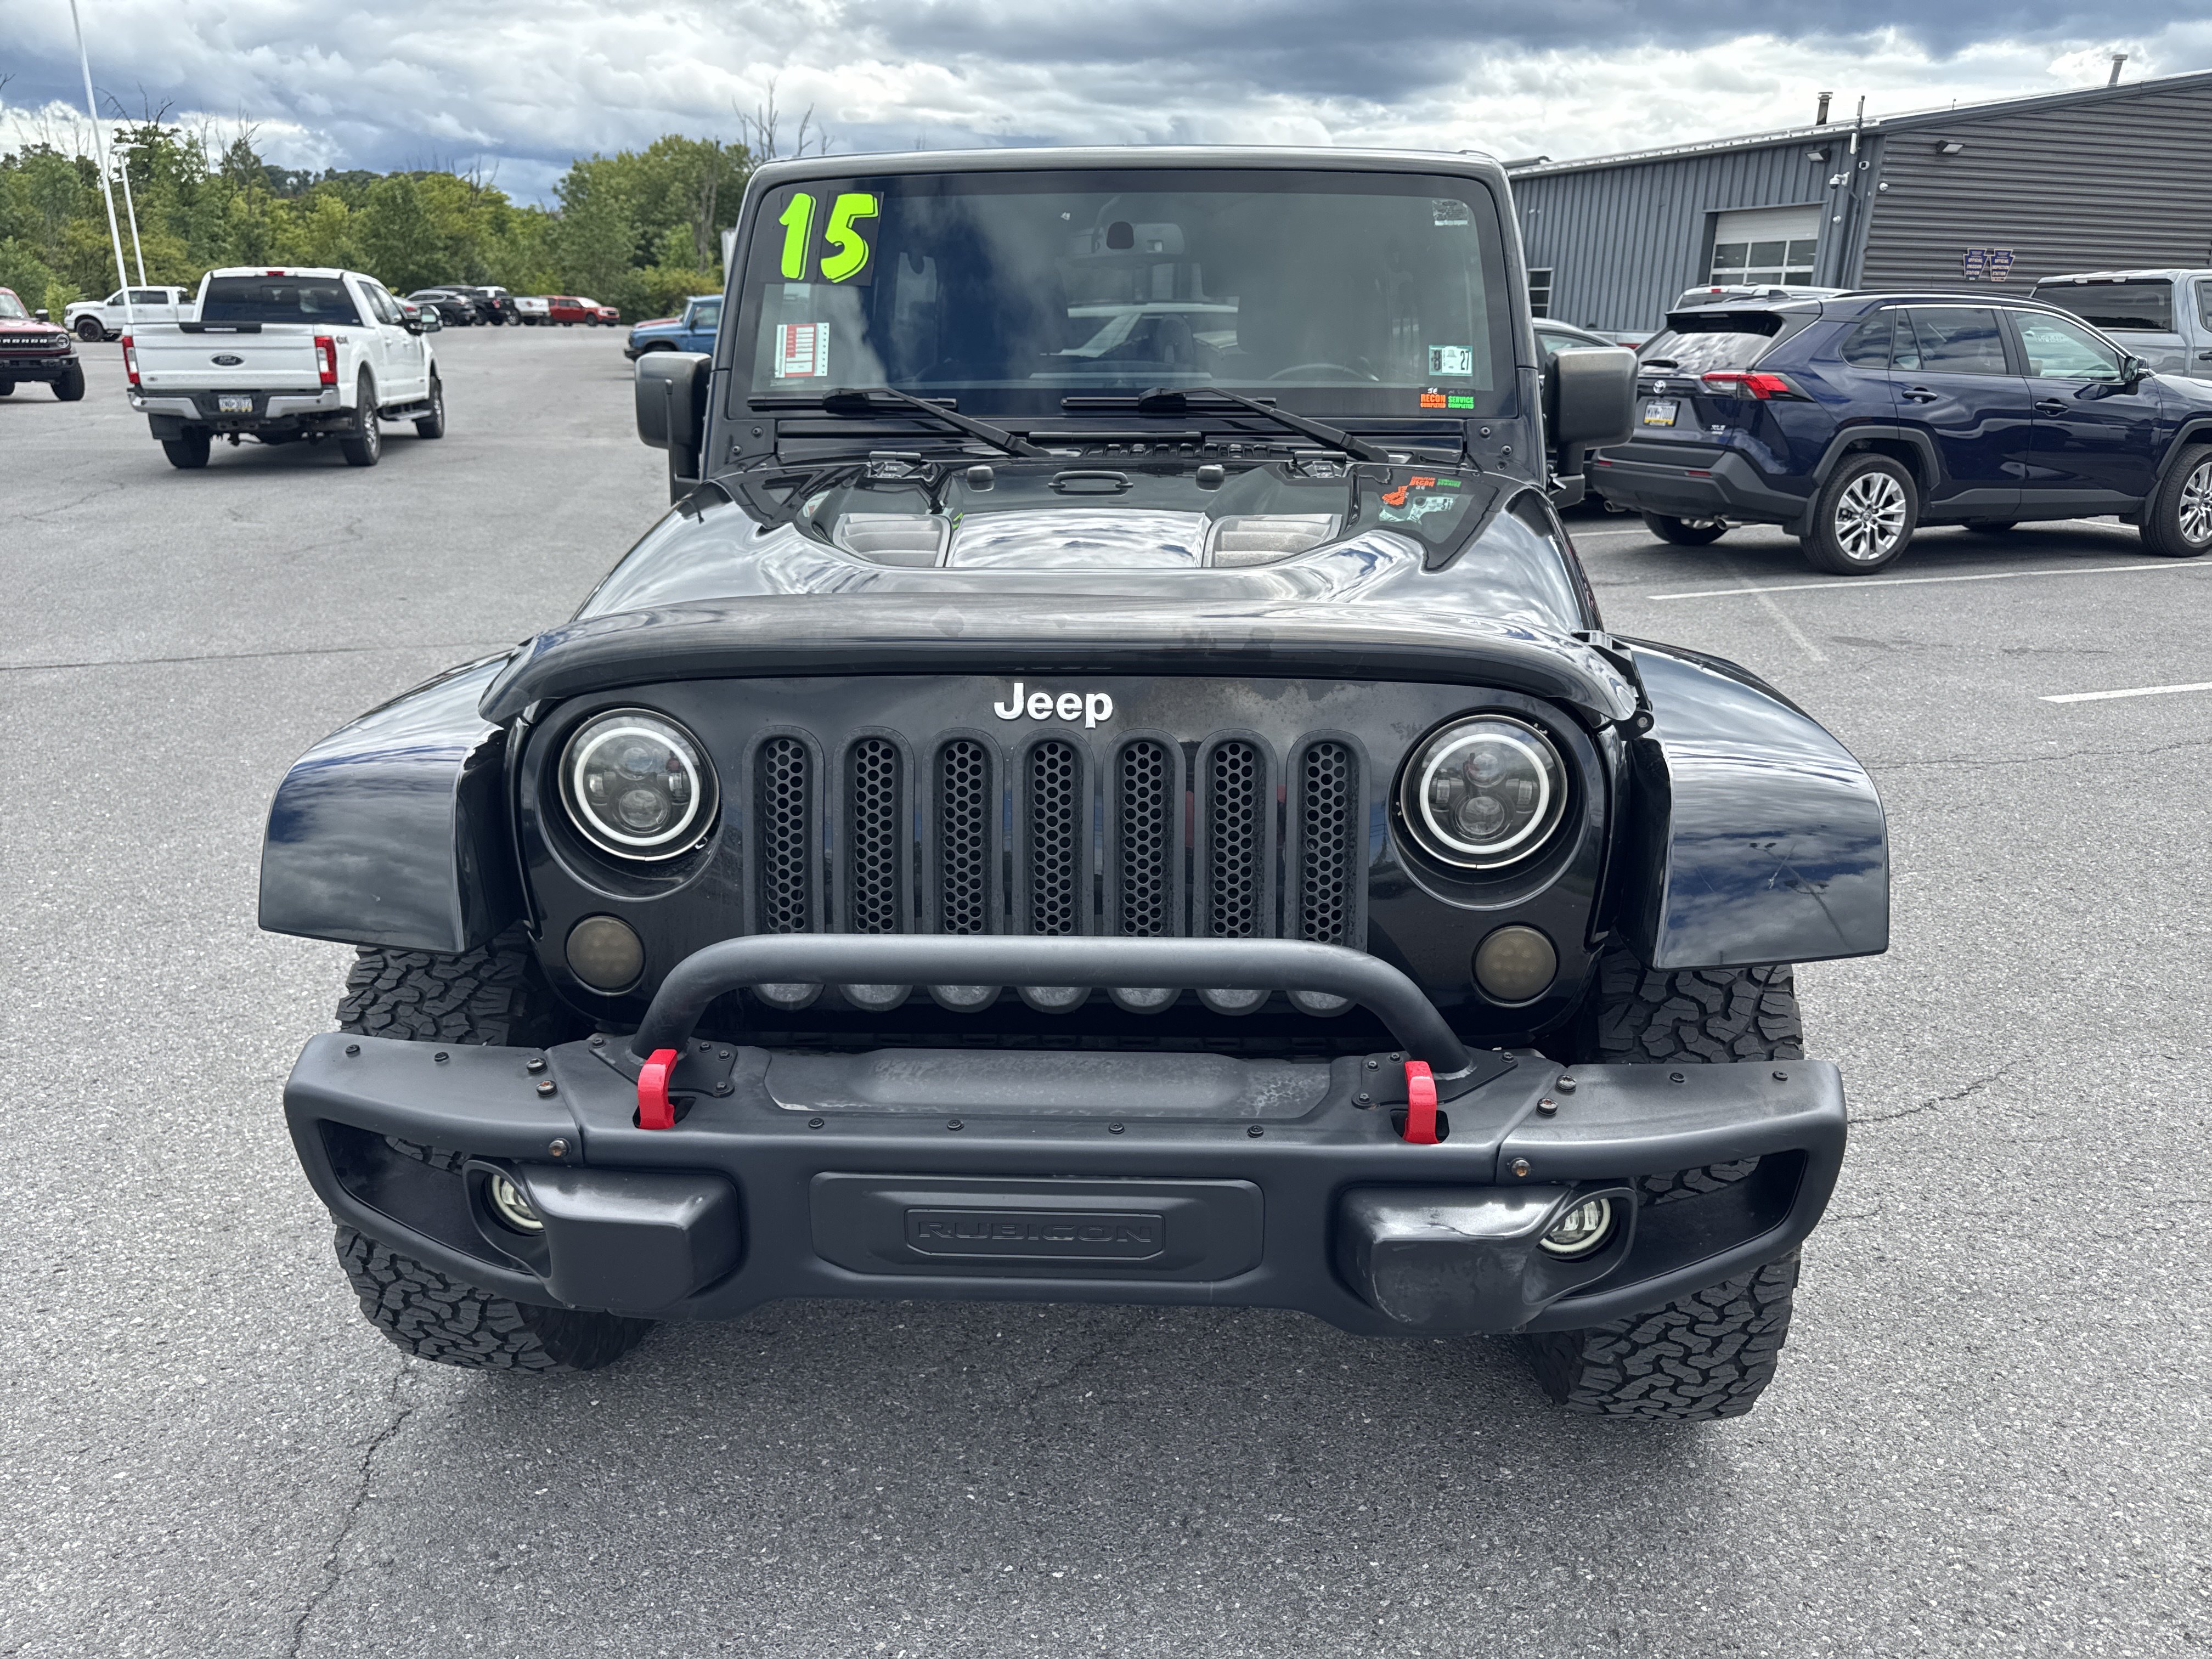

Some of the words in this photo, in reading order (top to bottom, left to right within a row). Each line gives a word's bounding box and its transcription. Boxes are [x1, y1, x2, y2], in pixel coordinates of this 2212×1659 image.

[778, 193, 878, 284] 15
[1460, 350, 1470, 371] 27
[1420, 394, 1446, 403] RECON
[994, 682, 1113, 729] Jeep
[918, 1221, 1152, 1243] RUBICON
